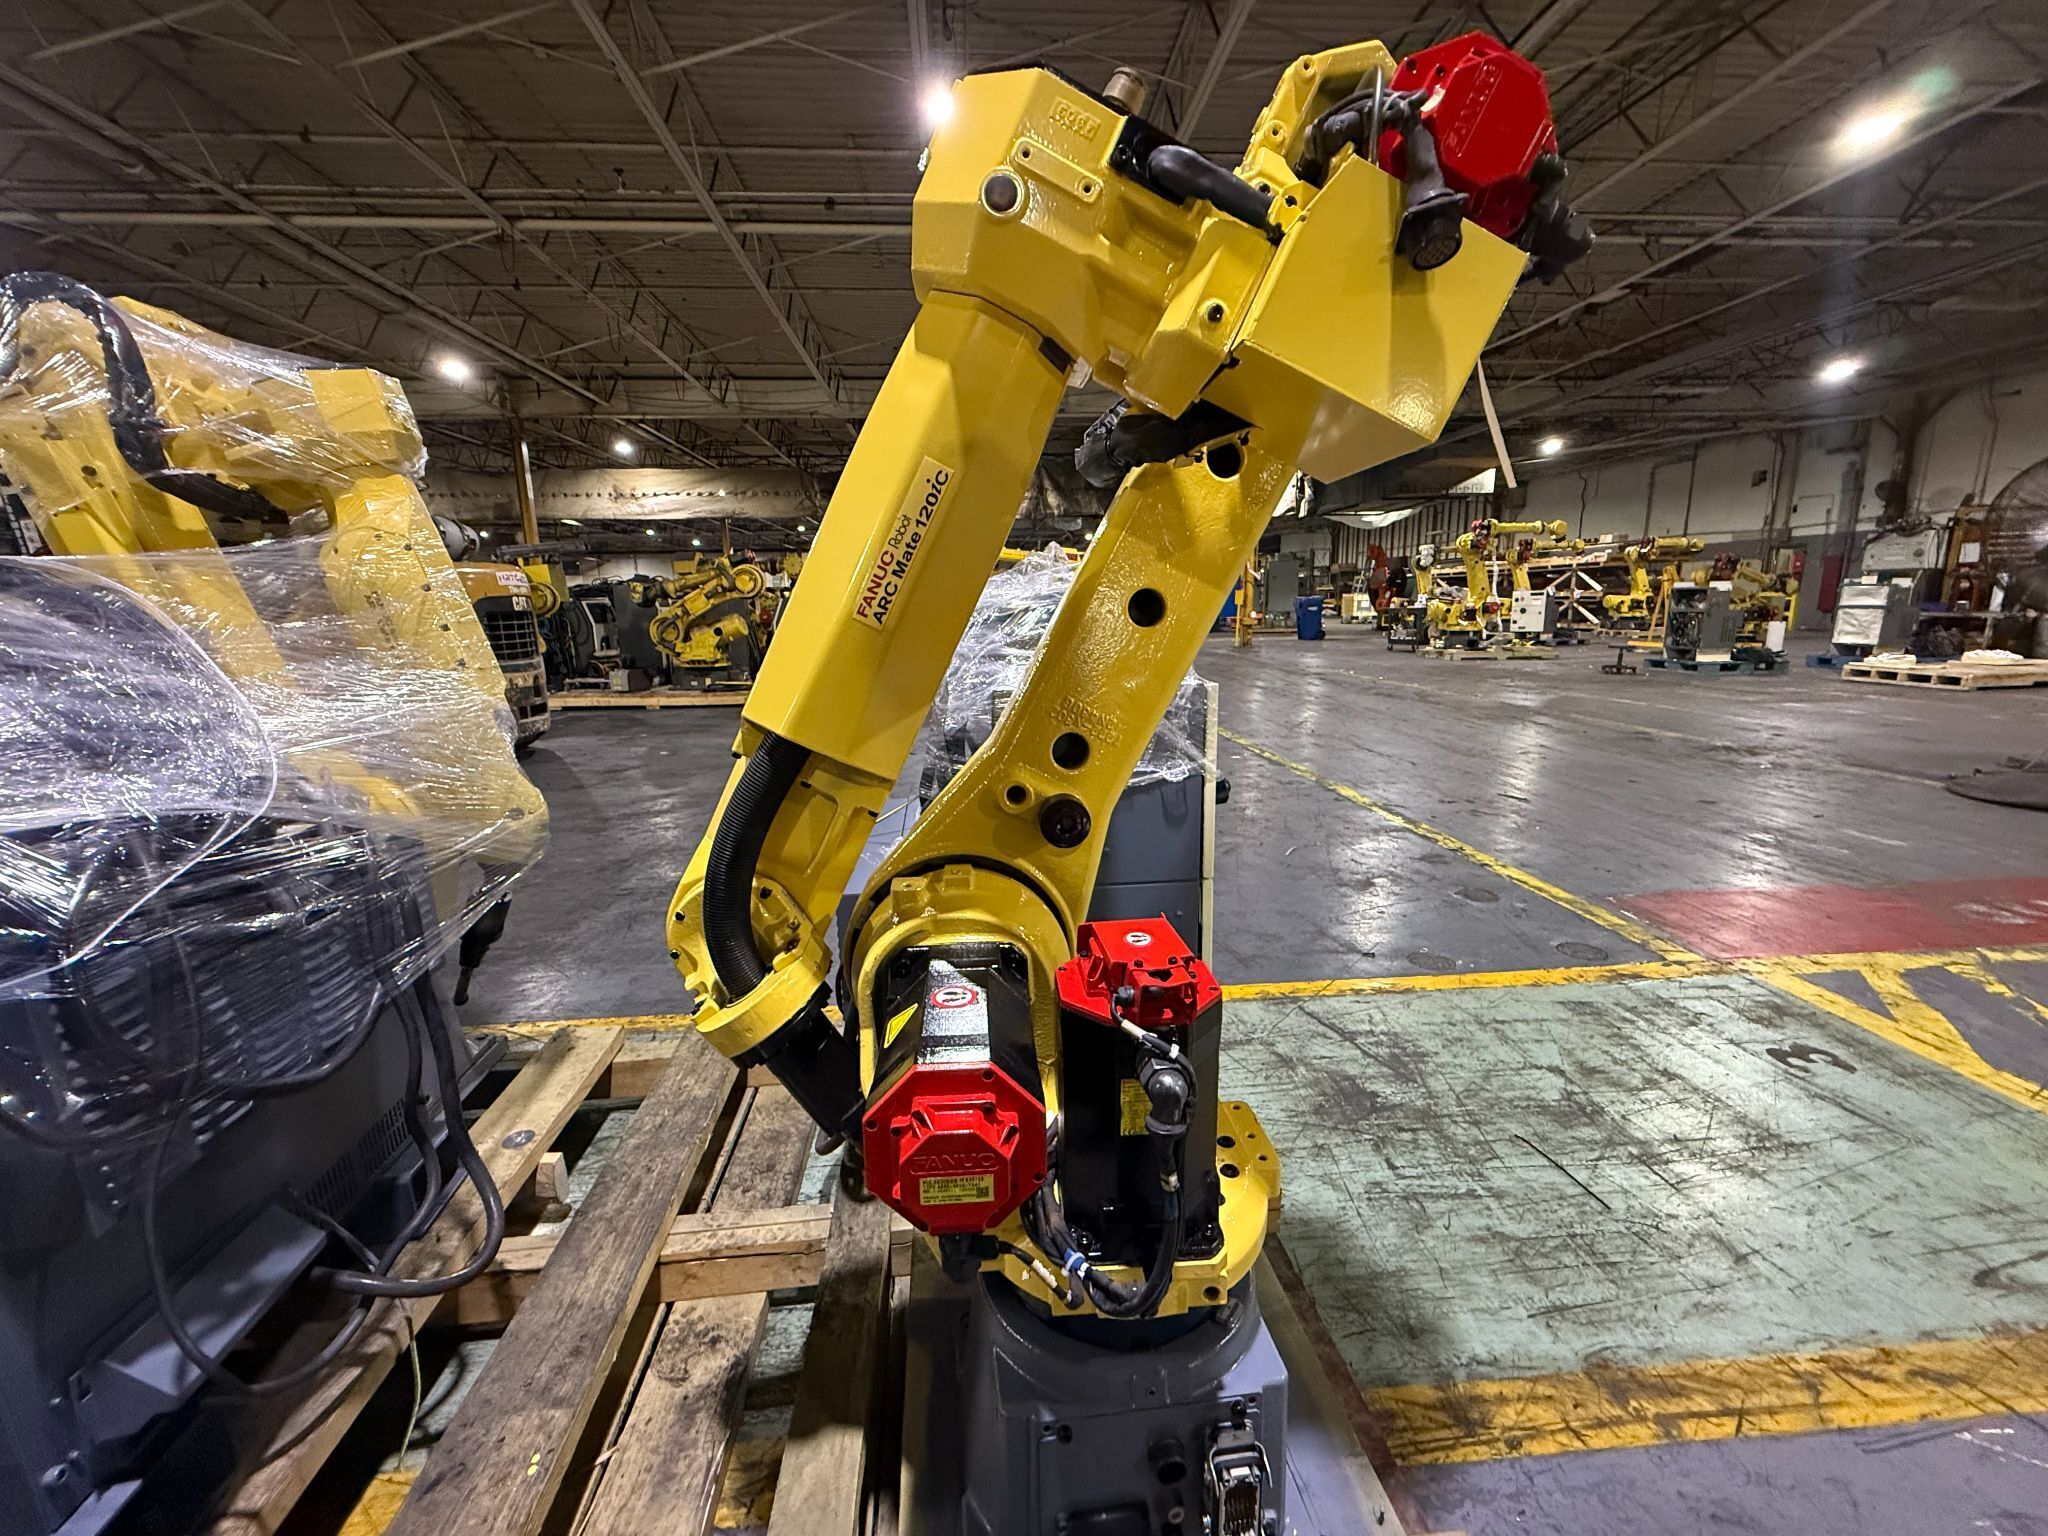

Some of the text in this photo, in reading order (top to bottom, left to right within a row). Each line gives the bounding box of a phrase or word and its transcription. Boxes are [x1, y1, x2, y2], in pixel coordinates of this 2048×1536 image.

[857, 513, 912, 618] FANUC Robot
[873, 470, 949, 625] ARC Mate 120iC
